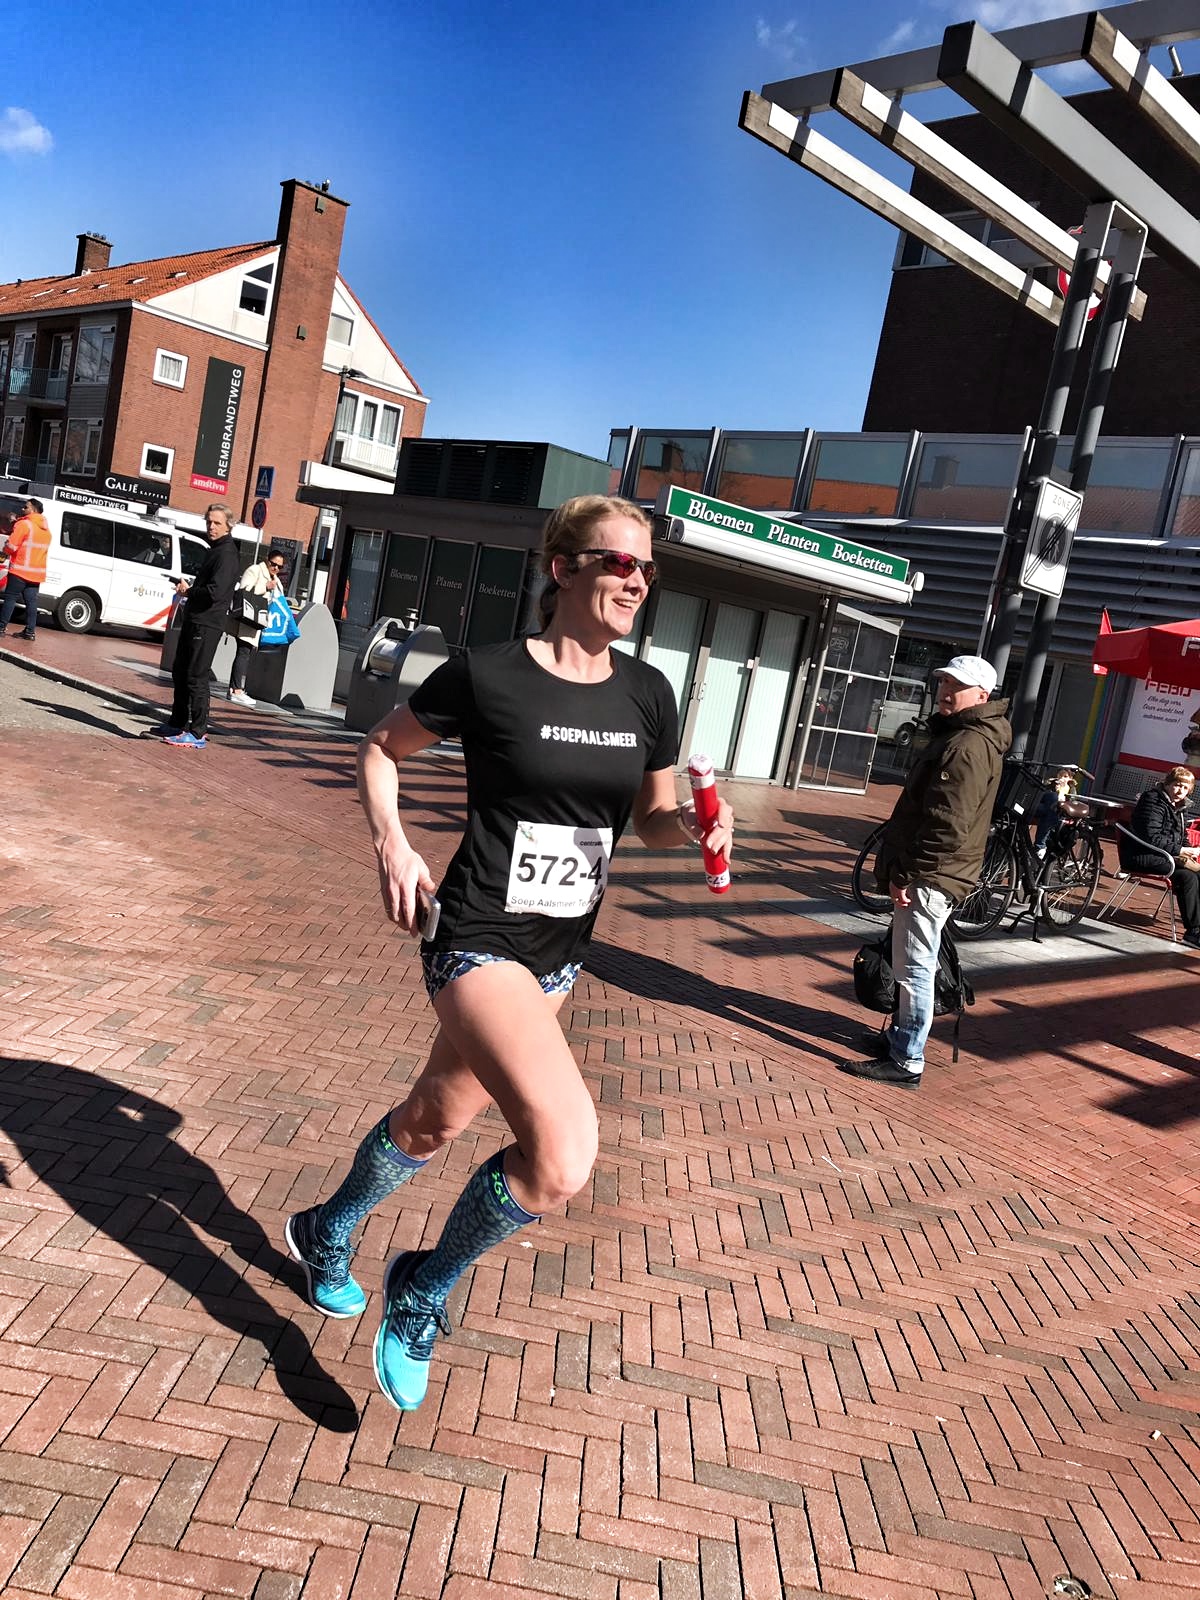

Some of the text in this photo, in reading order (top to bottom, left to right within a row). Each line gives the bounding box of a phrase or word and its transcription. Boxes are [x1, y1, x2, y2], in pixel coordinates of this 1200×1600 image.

[217, 368, 242, 478] REMBRANDTWEG
[59, 491, 126, 511] REMBRANDTWEG
[1052, 494, 1072, 511] ZONE
[686, 498, 894, 576] Bloemen Planten Boeketten
[390, 568, 517, 600] Bloemen Planten Boeketten
[540, 724, 638, 748] #SOEPAALSMEER
[516, 852, 602, 886] 572-4
[511, 895, 535, 907] Soep
[537, 898, 576, 908] Aalsmeer
